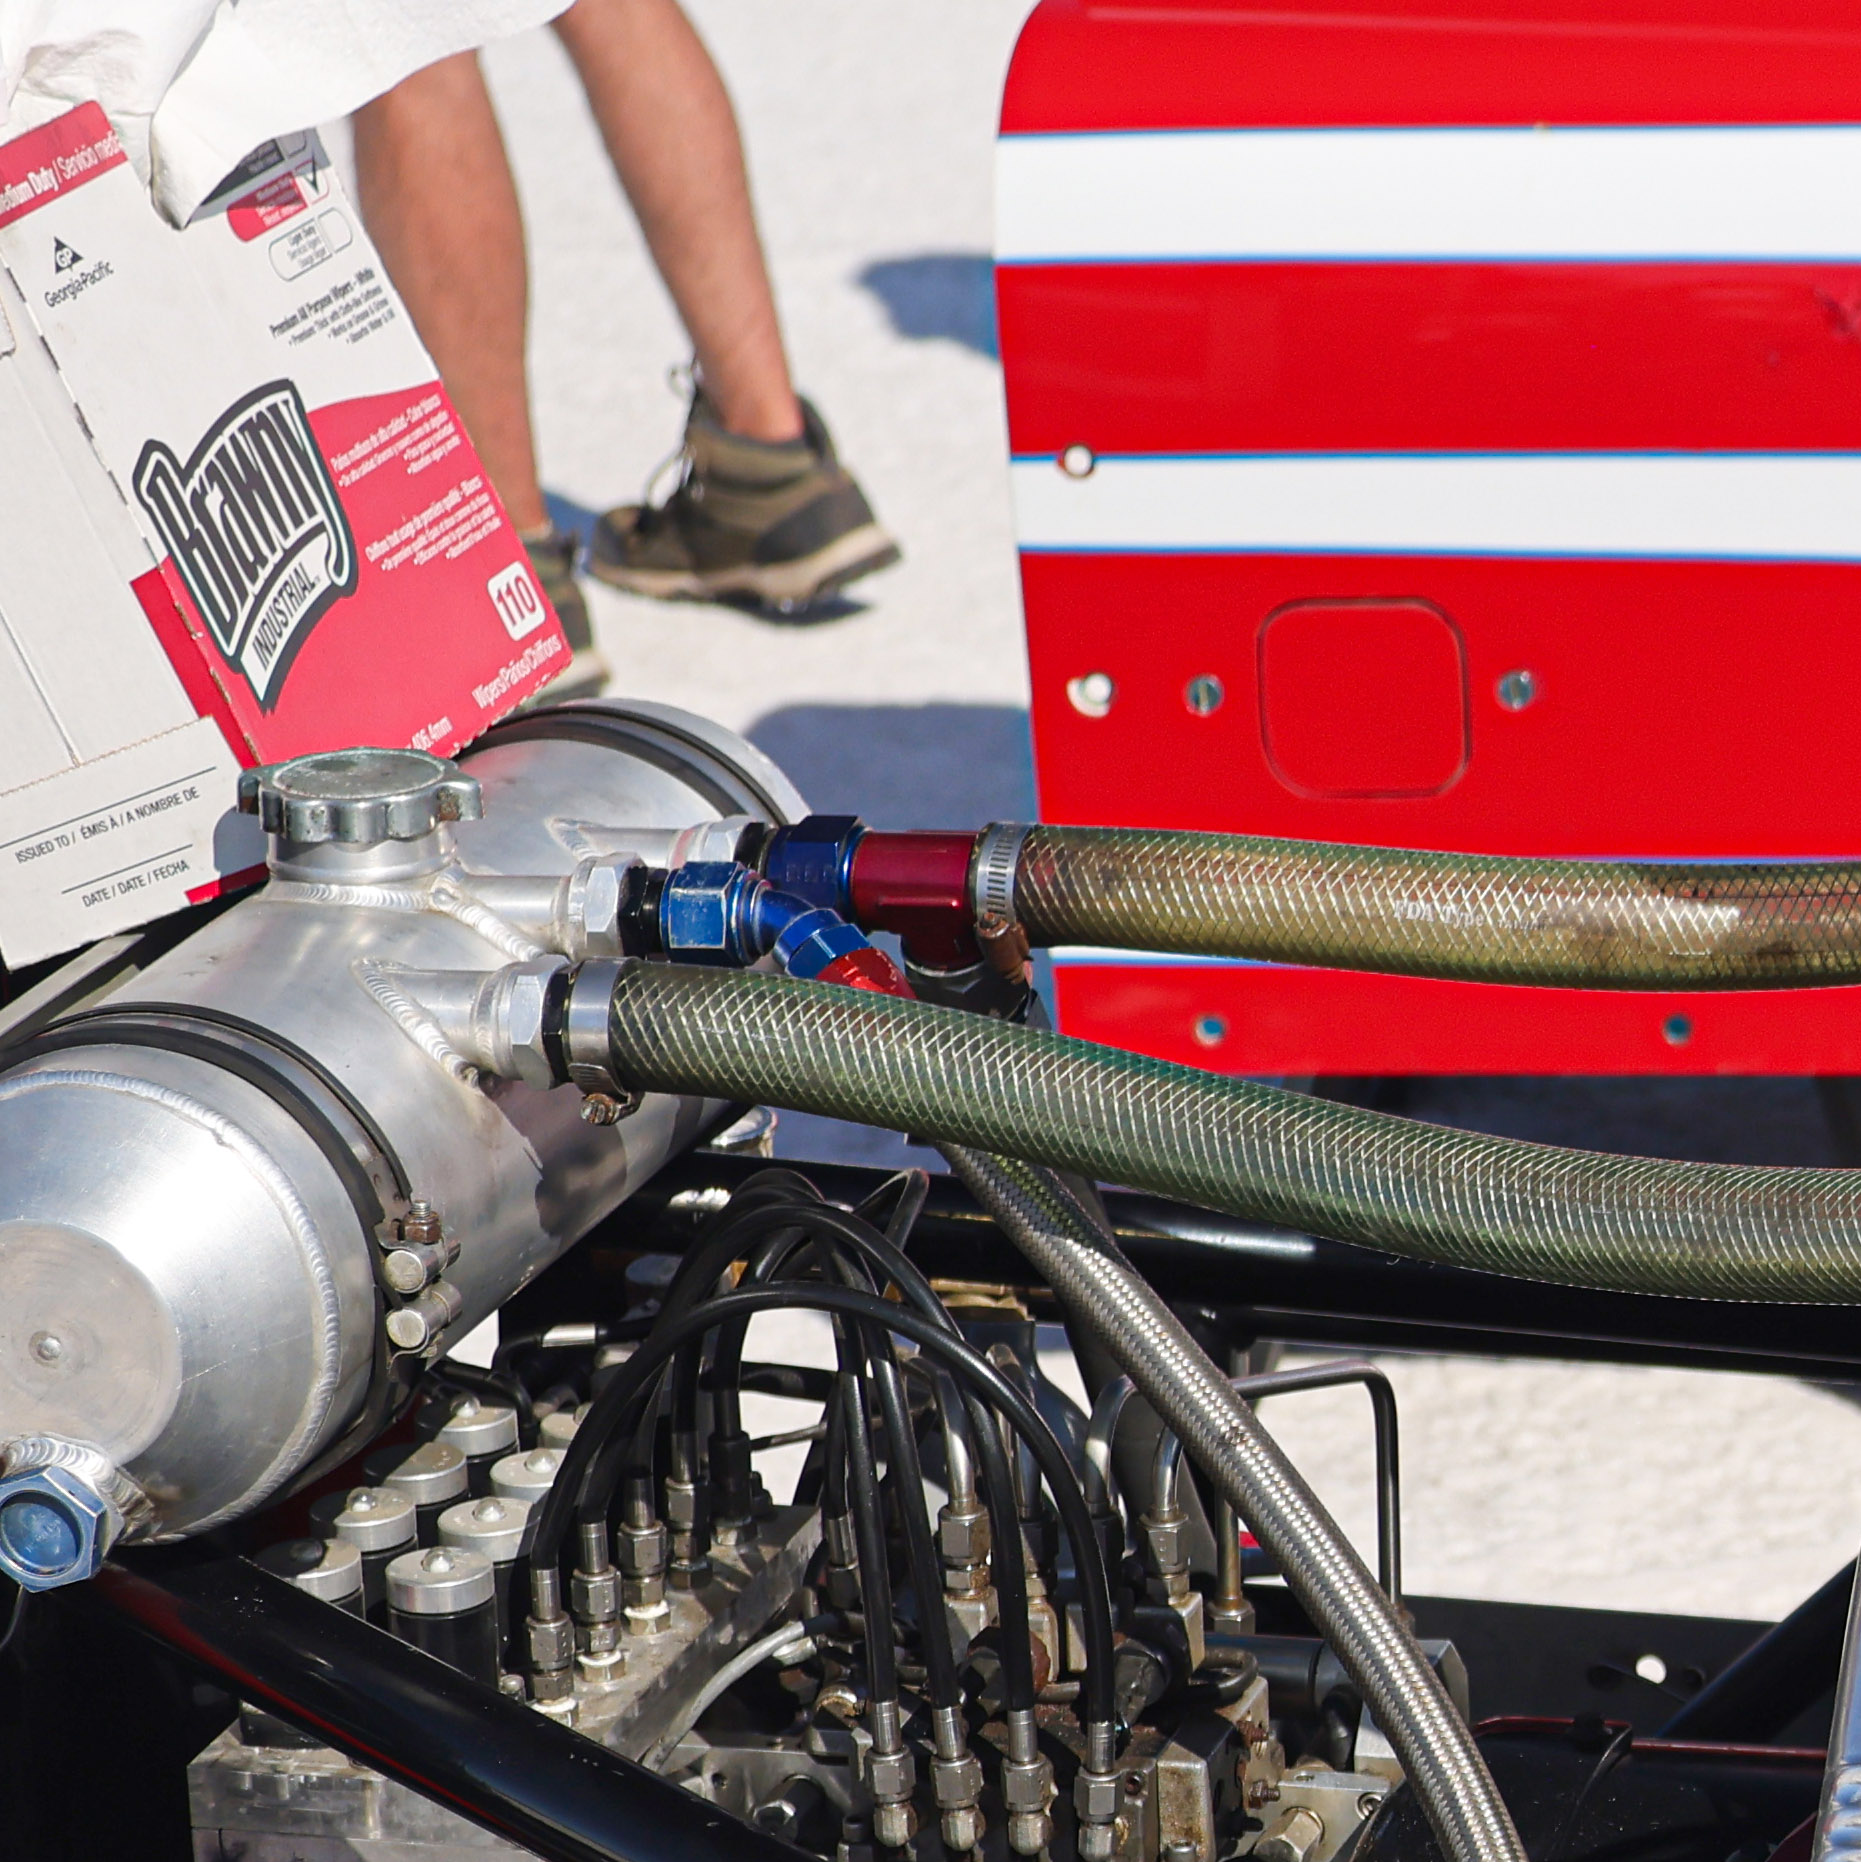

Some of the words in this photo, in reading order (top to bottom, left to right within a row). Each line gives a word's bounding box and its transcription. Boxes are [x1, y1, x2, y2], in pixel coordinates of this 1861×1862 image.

[27, 162, 58, 192] Duty
[56, 247, 73, 268] GP
[250, 567, 317, 671] INDUSTRIAL
[496, 575, 537, 626] 110
[15, 840, 54, 864] ISSUED
[54, 834, 70, 849] TO
[80, 820, 109, 841] ÉMIS
[126, 811, 136, 824] A
[135, 794, 183, 819] NOMBRE
[182, 786, 200, 802] DE
[82, 887, 111, 908] DATE
[117, 875, 147, 896] DATE
[153, 860, 190, 882] FECHA
